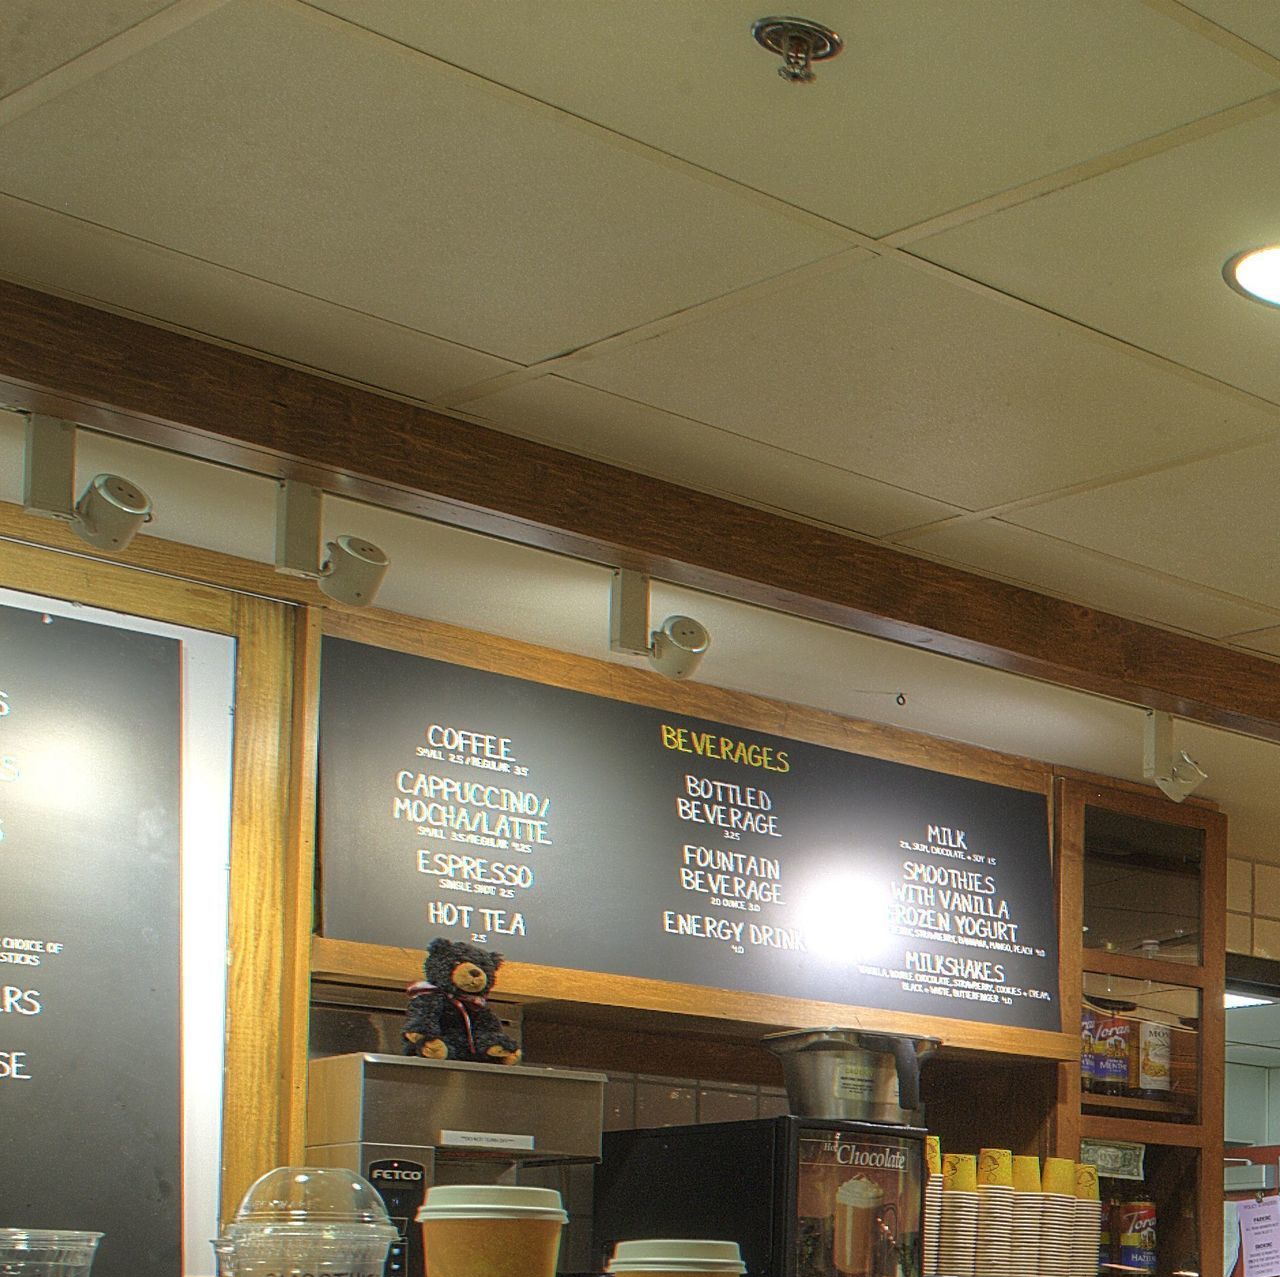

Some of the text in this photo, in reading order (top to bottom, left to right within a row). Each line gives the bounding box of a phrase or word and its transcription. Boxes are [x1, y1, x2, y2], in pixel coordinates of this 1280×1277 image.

[427, 724, 516, 762] COFFEE
[661, 724, 791, 773] BEVERAGES
[685, 774, 772, 812] BOTTLED
[392, 797, 552, 845] MOCHA/LATTE
[676, 797, 783, 837] BEVERAGE
[927, 823, 968, 850] MILK
[416, 849, 534, 889] ESPRESSO
[683, 844, 781, 881] FOUNTAIN
[903, 861, 997, 894] SMOOTHIES
[680, 868, 787, 905] BEVERAGE
[891, 881, 1010, 920] WITH VANILLA
[427, 901, 527, 936] HOT TEA
[663, 910, 745, 943] ENERGY
[954, 914, 1018, 943] YOGURT
[2, 937, 45, 953] CHOICE
[45, 942, 64, 954] OF
[905, 950, 1005, 983] MILKSHAKES
[836, 1144, 906, 1169] Chocolate
[372, 1169, 422, 1181] FETCO
